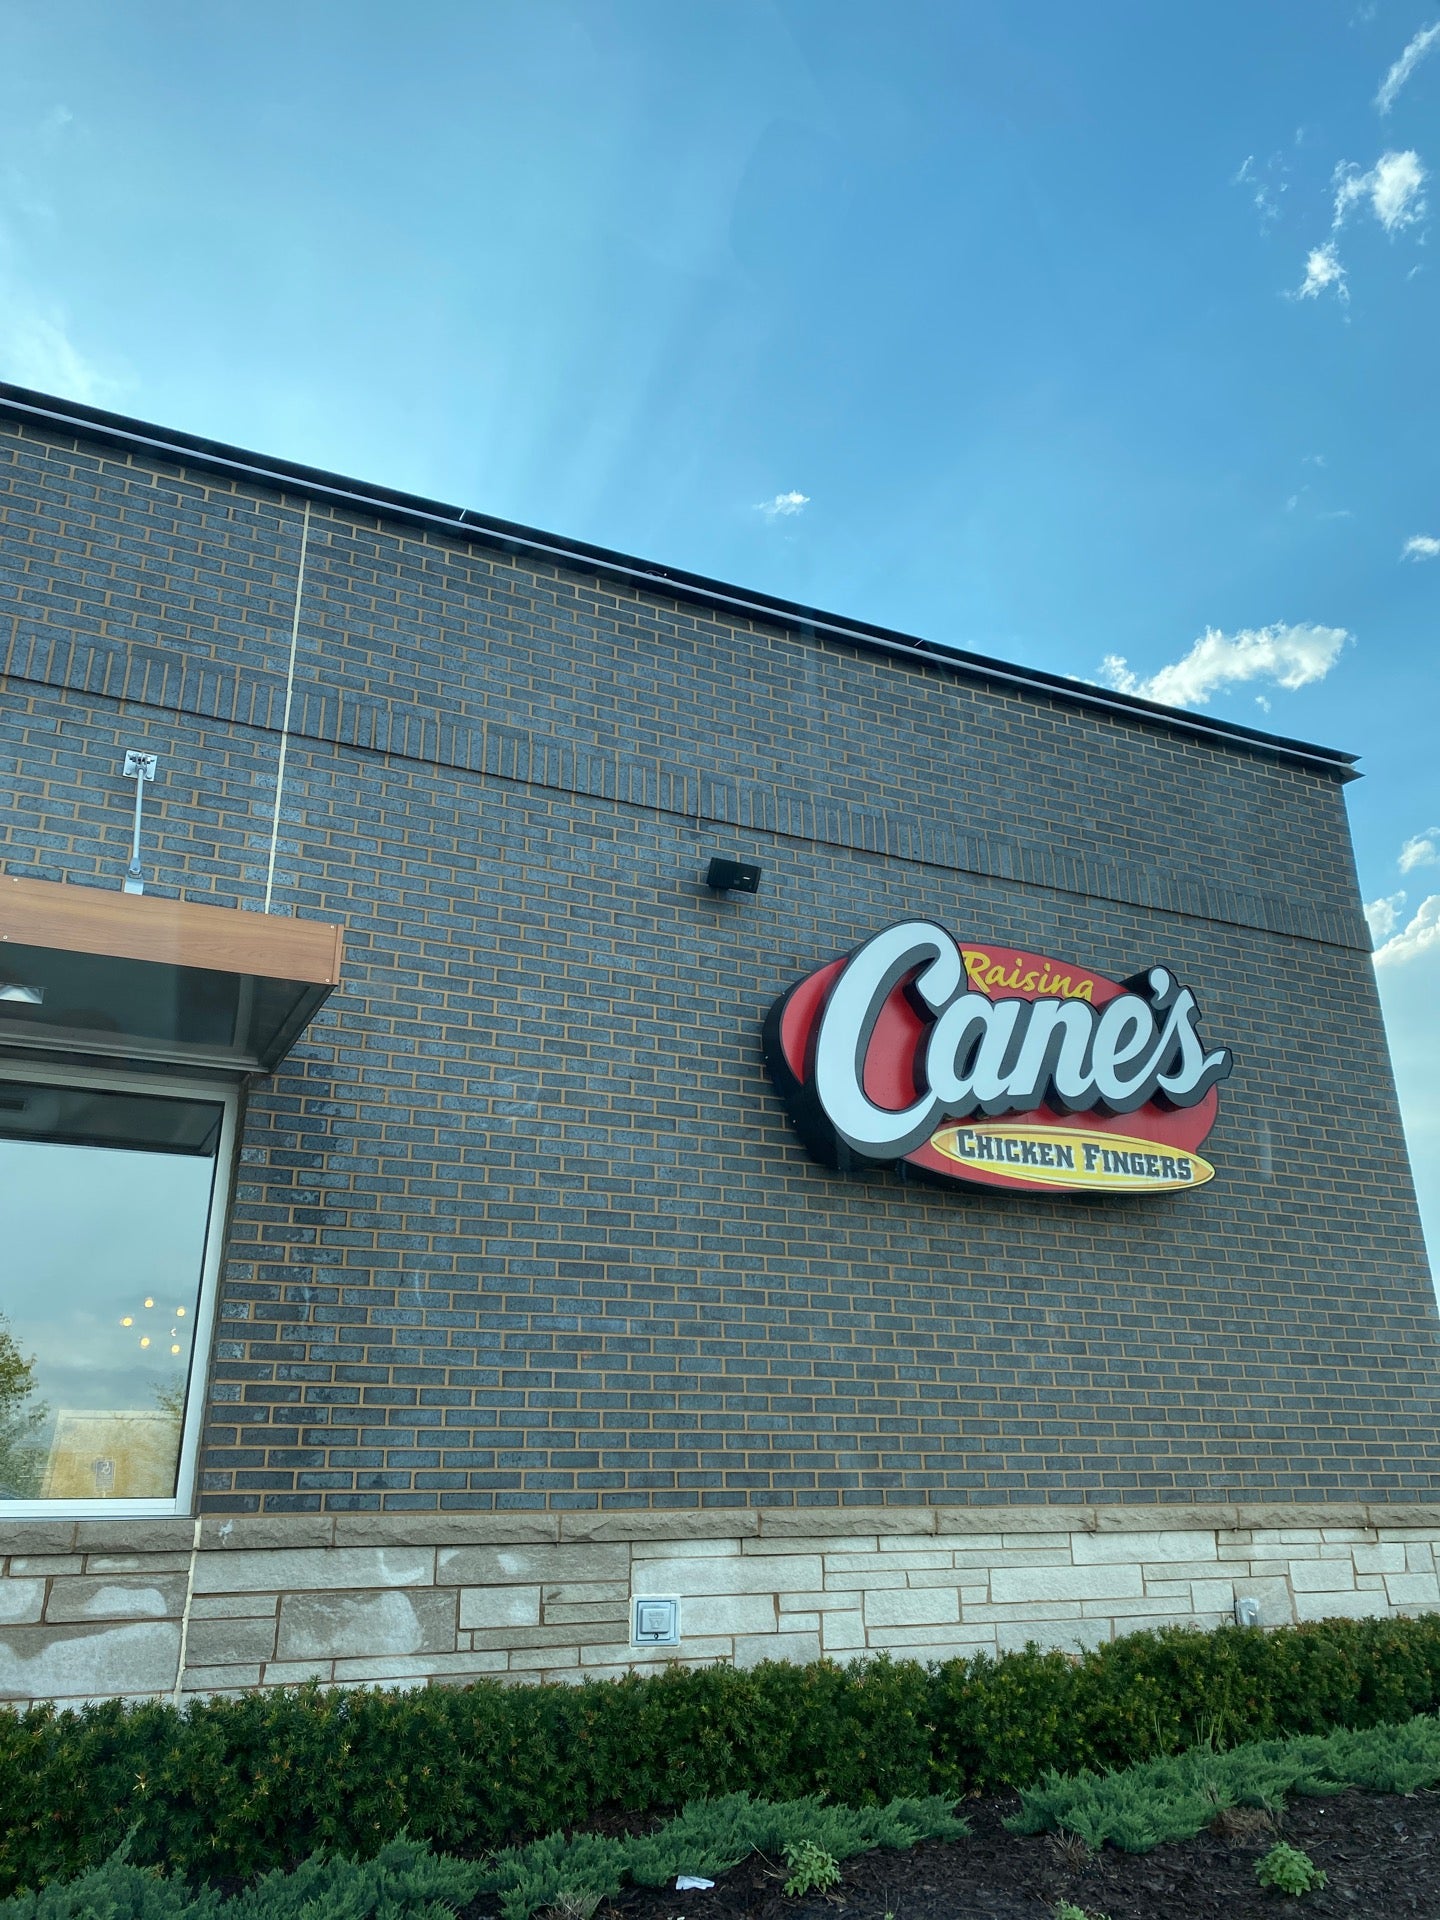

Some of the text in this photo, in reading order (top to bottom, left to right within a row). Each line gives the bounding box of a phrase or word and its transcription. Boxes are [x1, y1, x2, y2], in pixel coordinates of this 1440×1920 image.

[815, 922, 1226, 1143] Cane's
[957, 1129, 1193, 1180] CHICKEN FINGERS
